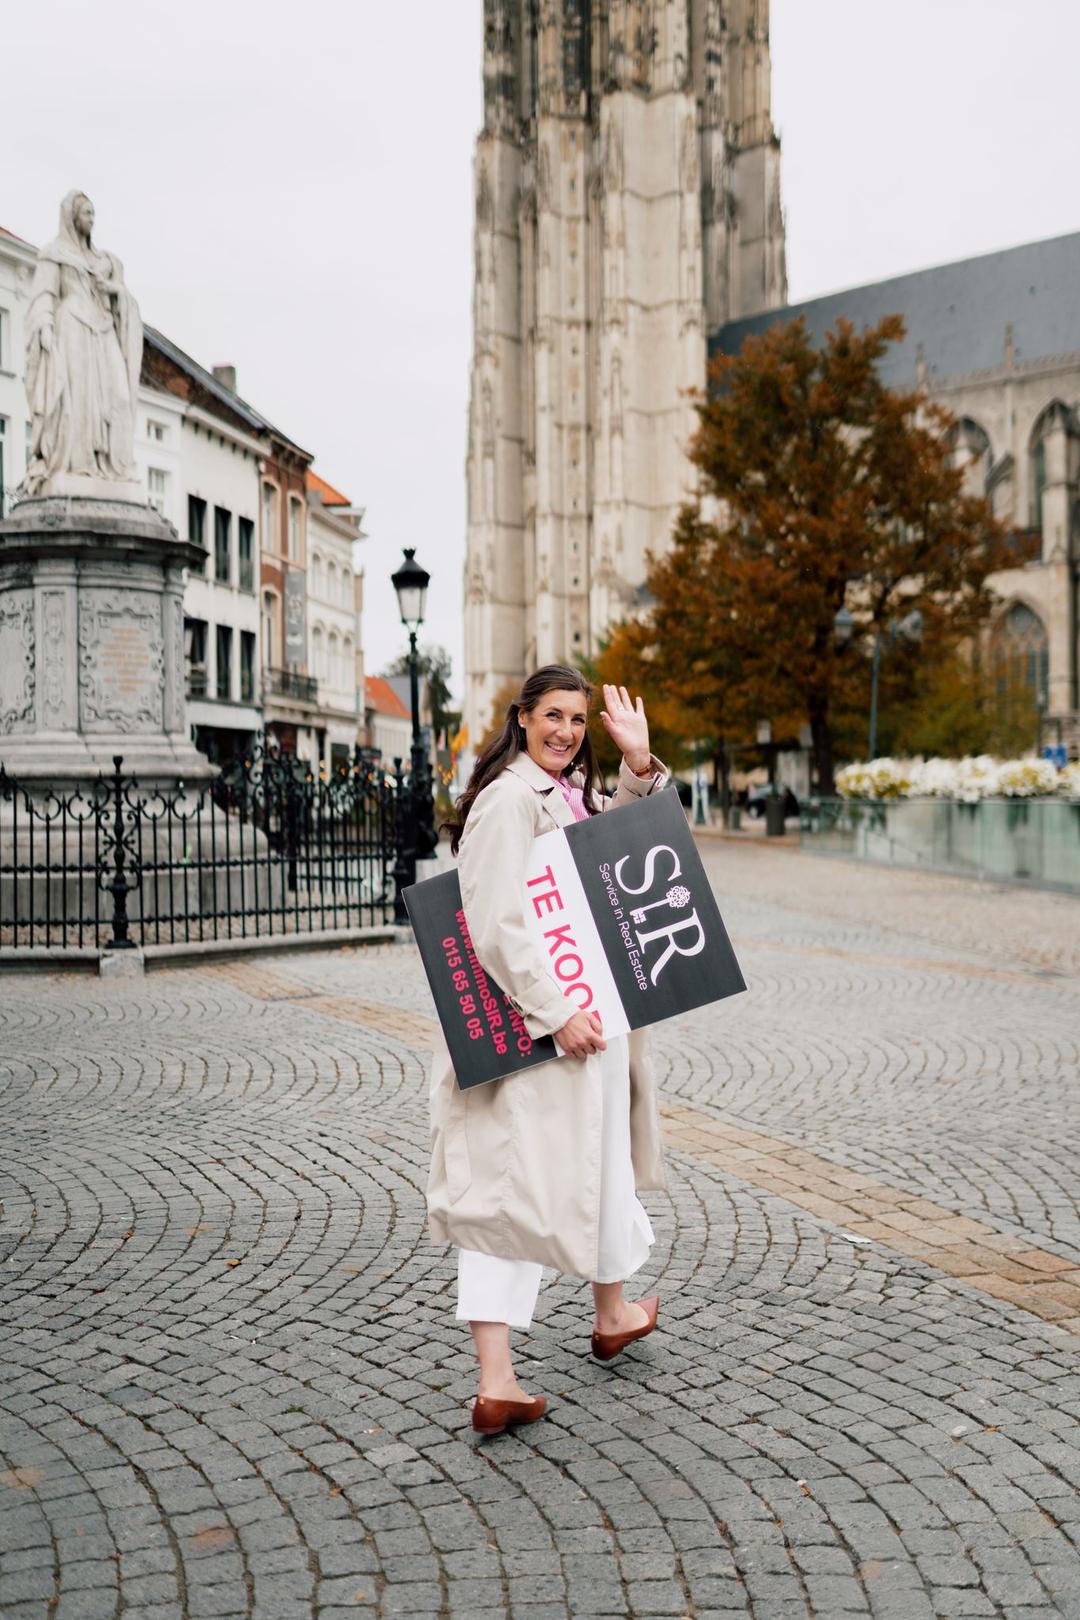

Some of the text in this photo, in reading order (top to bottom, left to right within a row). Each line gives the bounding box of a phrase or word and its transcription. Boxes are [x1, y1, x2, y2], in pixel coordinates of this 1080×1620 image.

[442, 937, 484, 1040] 015 65 50 05
[527, 865, 602, 1025] TE KOO
[599, 863, 648, 990] Service in Real Estate
